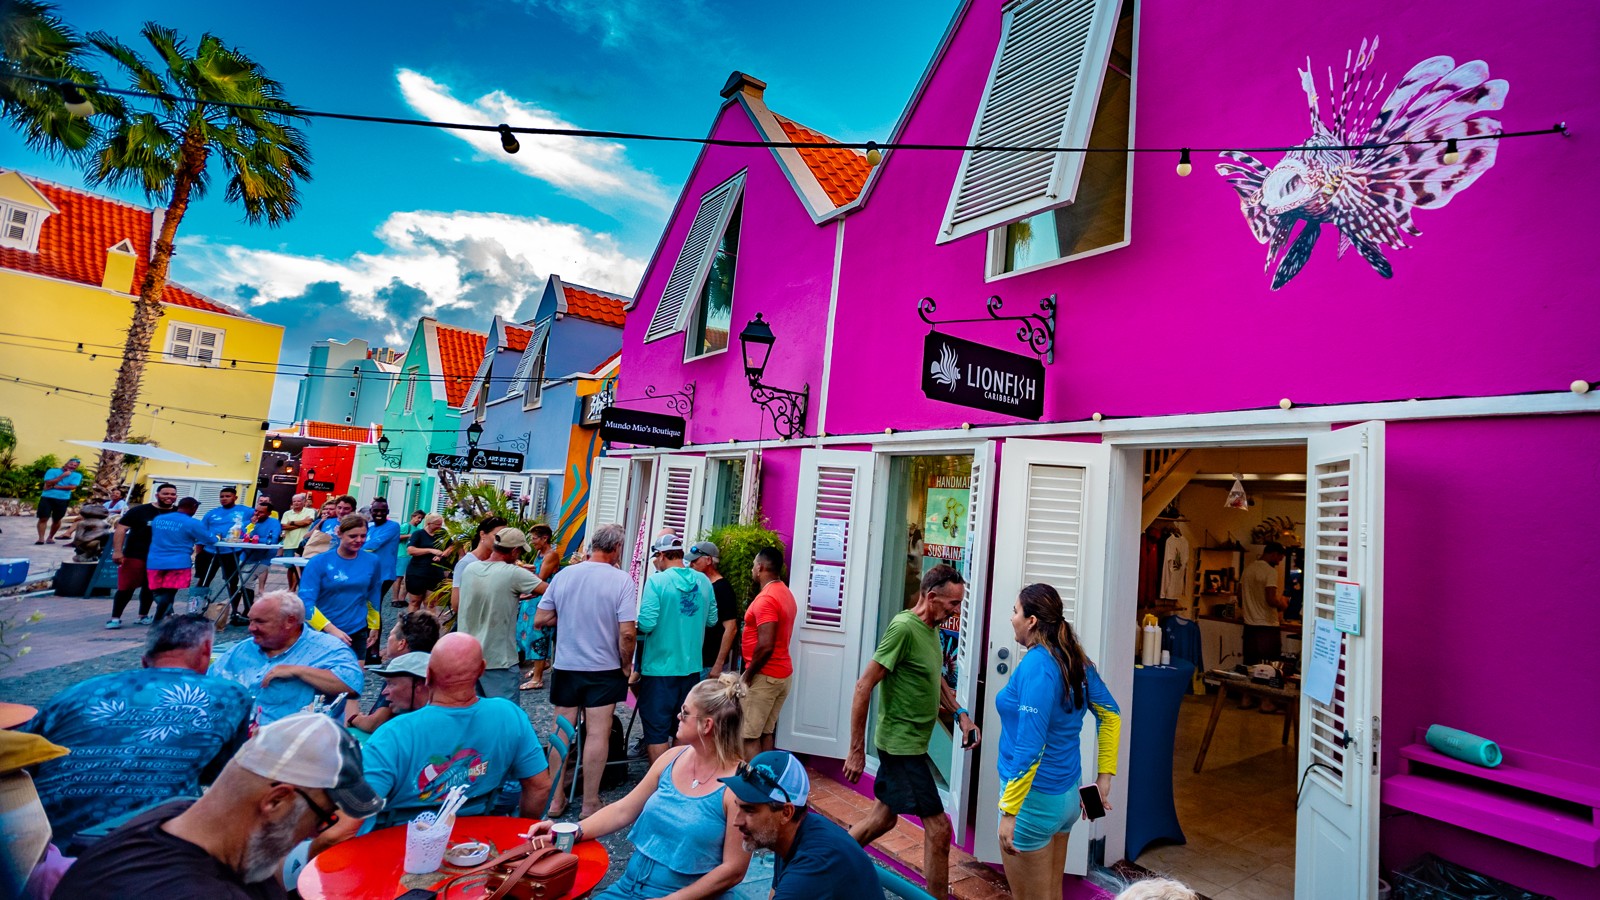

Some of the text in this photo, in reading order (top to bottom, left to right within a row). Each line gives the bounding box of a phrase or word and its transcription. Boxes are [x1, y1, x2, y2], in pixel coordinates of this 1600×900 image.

[967, 363, 1036, 401] LIONFISH
[984, 391, 1020, 406] CARIBBEAN
[604, 420, 681, 437] Mundo Mio's Boutique
[70, 745, 199, 757] IONFISHCENTRAL.ORG
